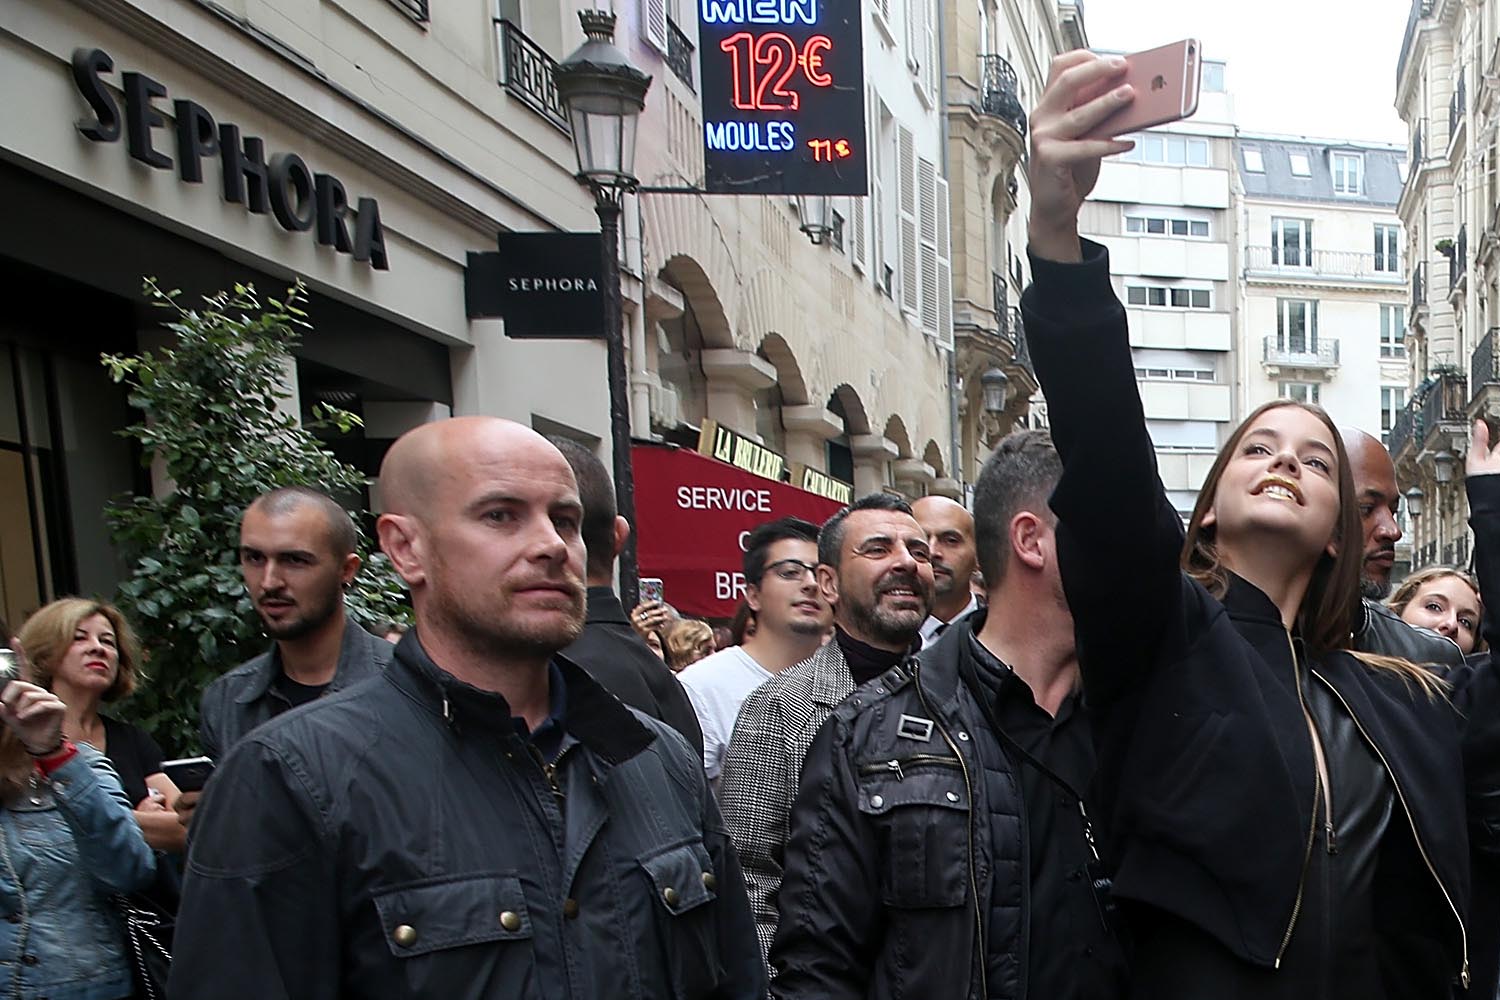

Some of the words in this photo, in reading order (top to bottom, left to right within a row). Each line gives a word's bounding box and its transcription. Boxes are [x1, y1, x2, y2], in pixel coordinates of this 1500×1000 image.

[720, 32, 833, 111] 12€
[705, 121, 795, 151] MOULES
[72, 48, 390, 271] SEPHORA
[508, 278, 598, 291] SEPHORA
[715, 426, 731, 463] LA
[677, 486, 772, 513] SERVICE
